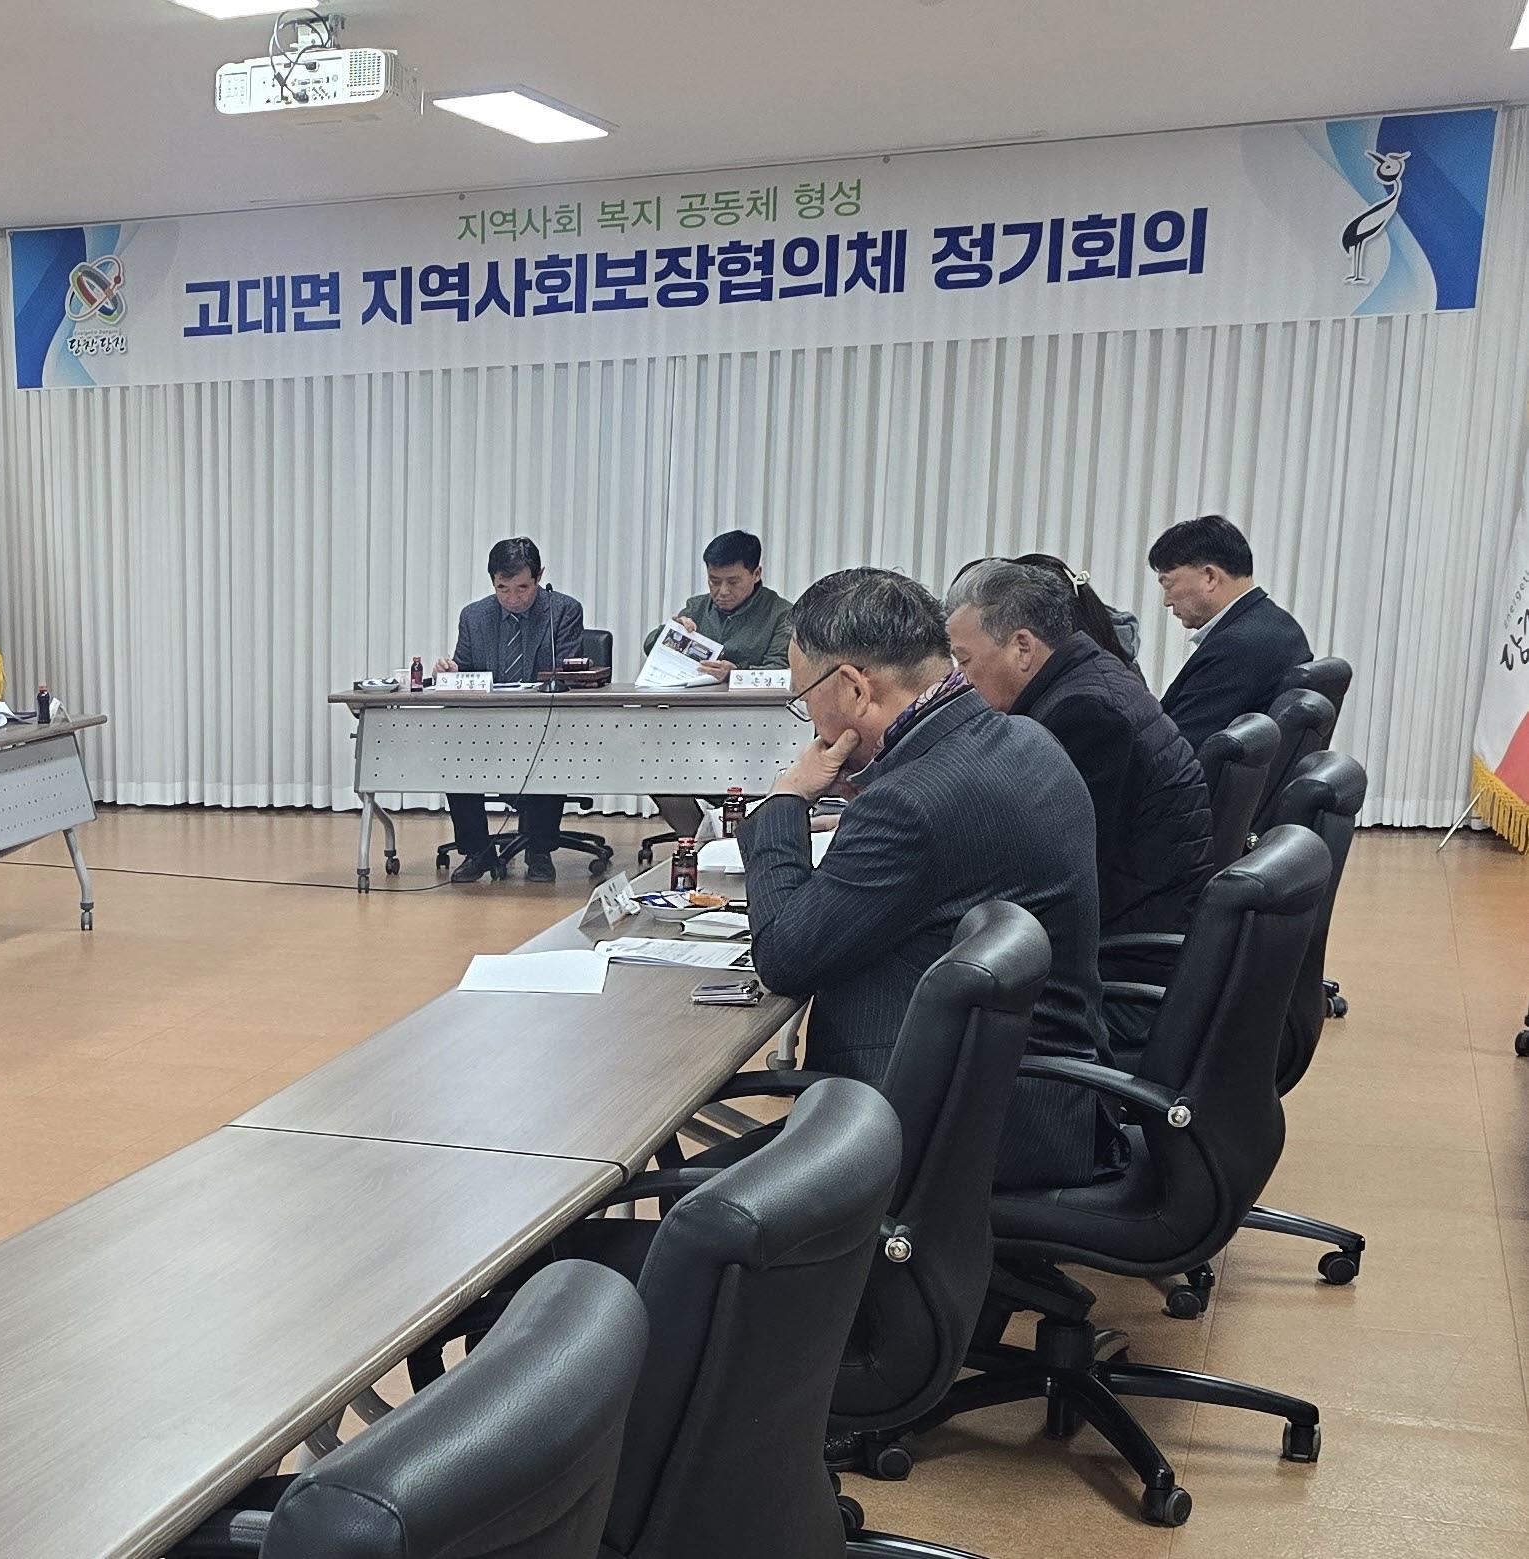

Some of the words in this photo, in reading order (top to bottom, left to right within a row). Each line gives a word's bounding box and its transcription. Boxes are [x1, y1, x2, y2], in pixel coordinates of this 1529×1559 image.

[457, 201, 583, 244] 지역사회
[597, 195, 662, 237] 복지
[676, 178, 779, 228] 공동체
[793, 178, 863, 219] 형성
[183, 271, 341, 338] 고대면
[360, 227, 907, 328] 지역사회보장협의체
[931, 206, 1209, 291] 정기회의
